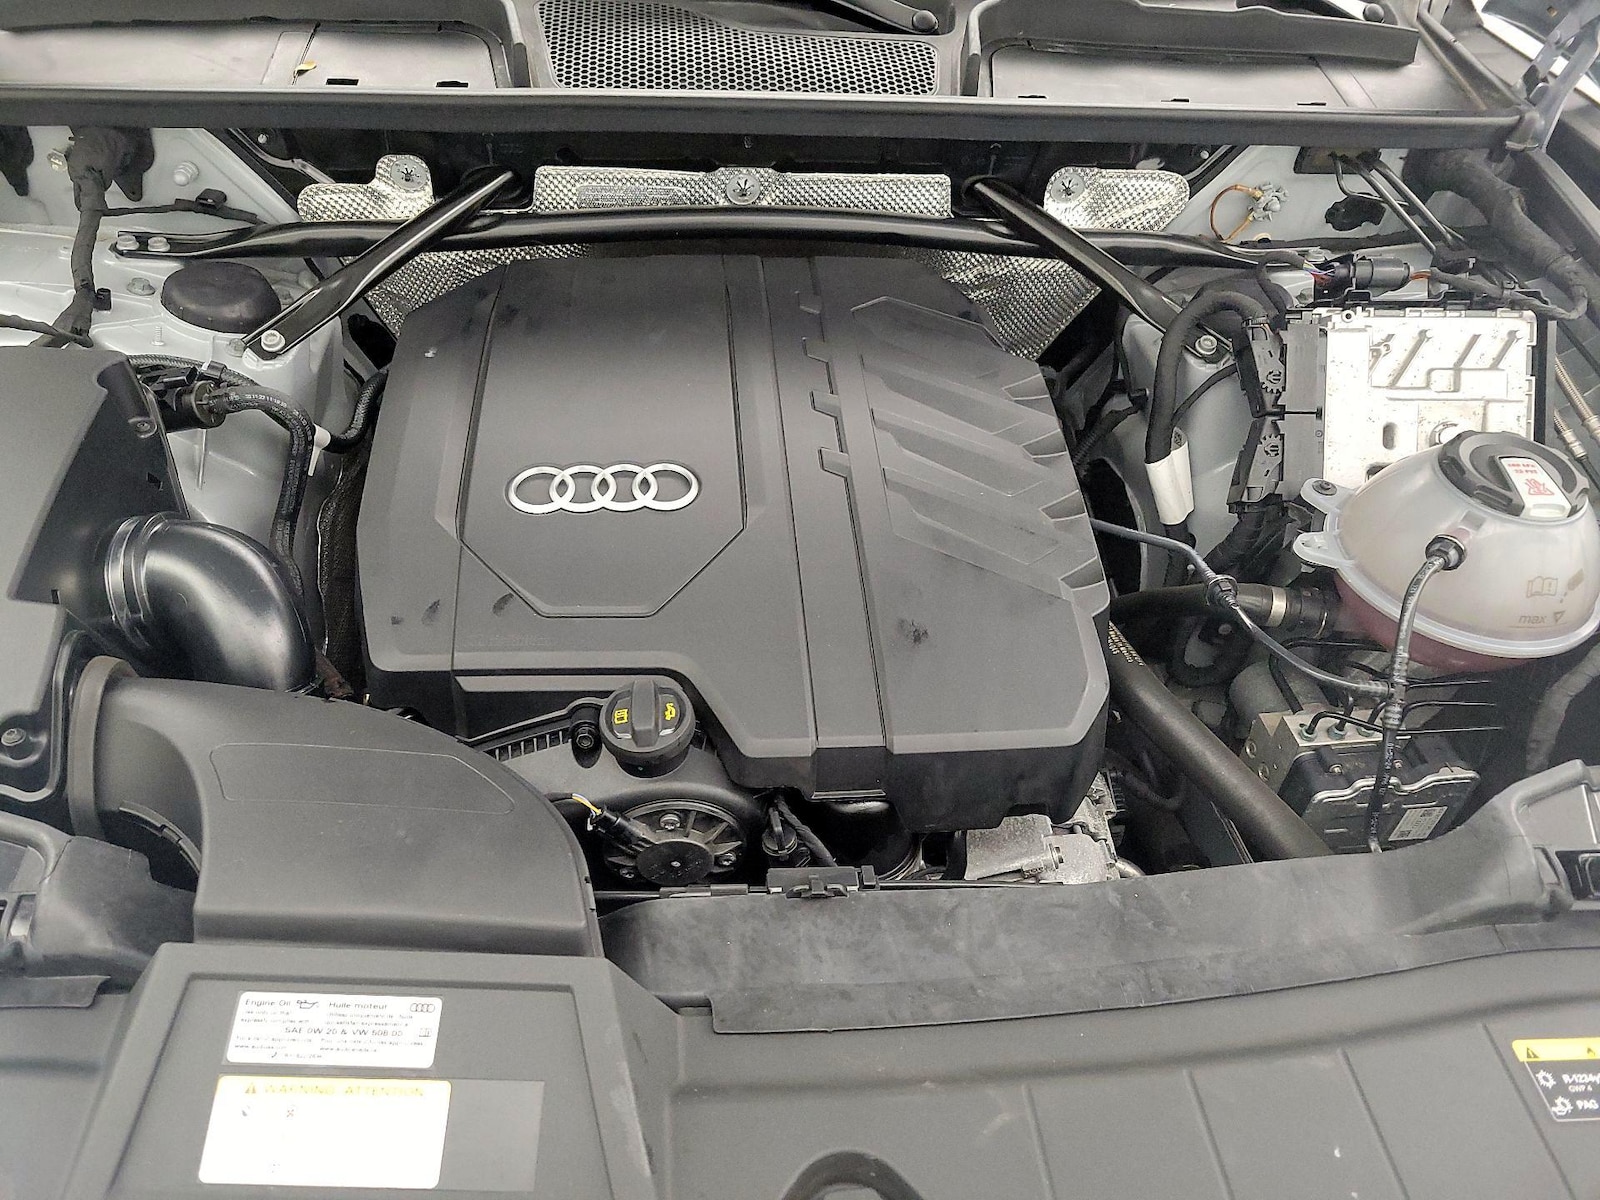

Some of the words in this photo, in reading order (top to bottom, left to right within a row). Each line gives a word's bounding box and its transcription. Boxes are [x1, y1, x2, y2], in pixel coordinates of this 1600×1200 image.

[1518, 615, 1547, 624] max
[245, 998, 276, 1007] Engine
[328, 1001, 351, 1009] Huile
[354, 1002, 388, 1010] moteur
[351, 1028, 369, 1036] VW
